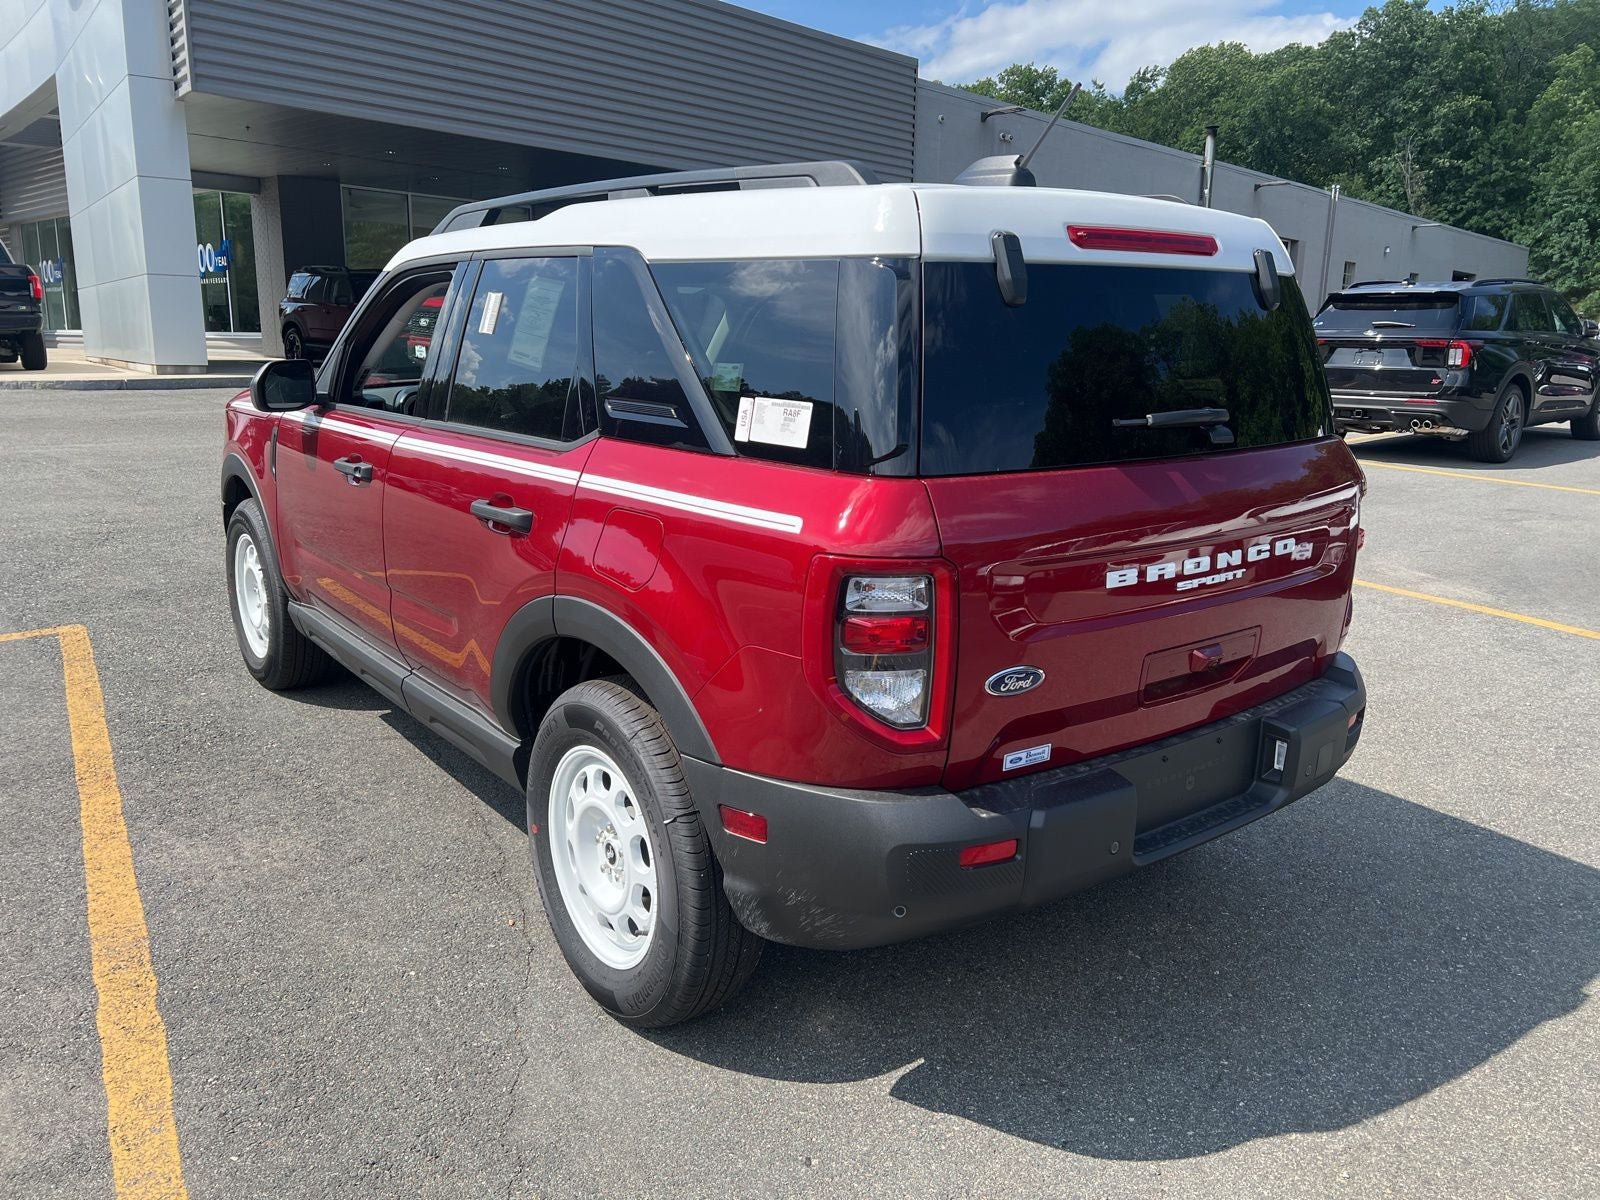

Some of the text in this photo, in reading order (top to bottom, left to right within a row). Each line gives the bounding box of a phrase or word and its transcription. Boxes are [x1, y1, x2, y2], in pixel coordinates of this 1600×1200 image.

[198, 242, 215, 273] 00
[741, 409, 749, 427] USA
[1105, 537, 1296, 589] BRONCO
[1176, 569, 1247, 591] SPORT
